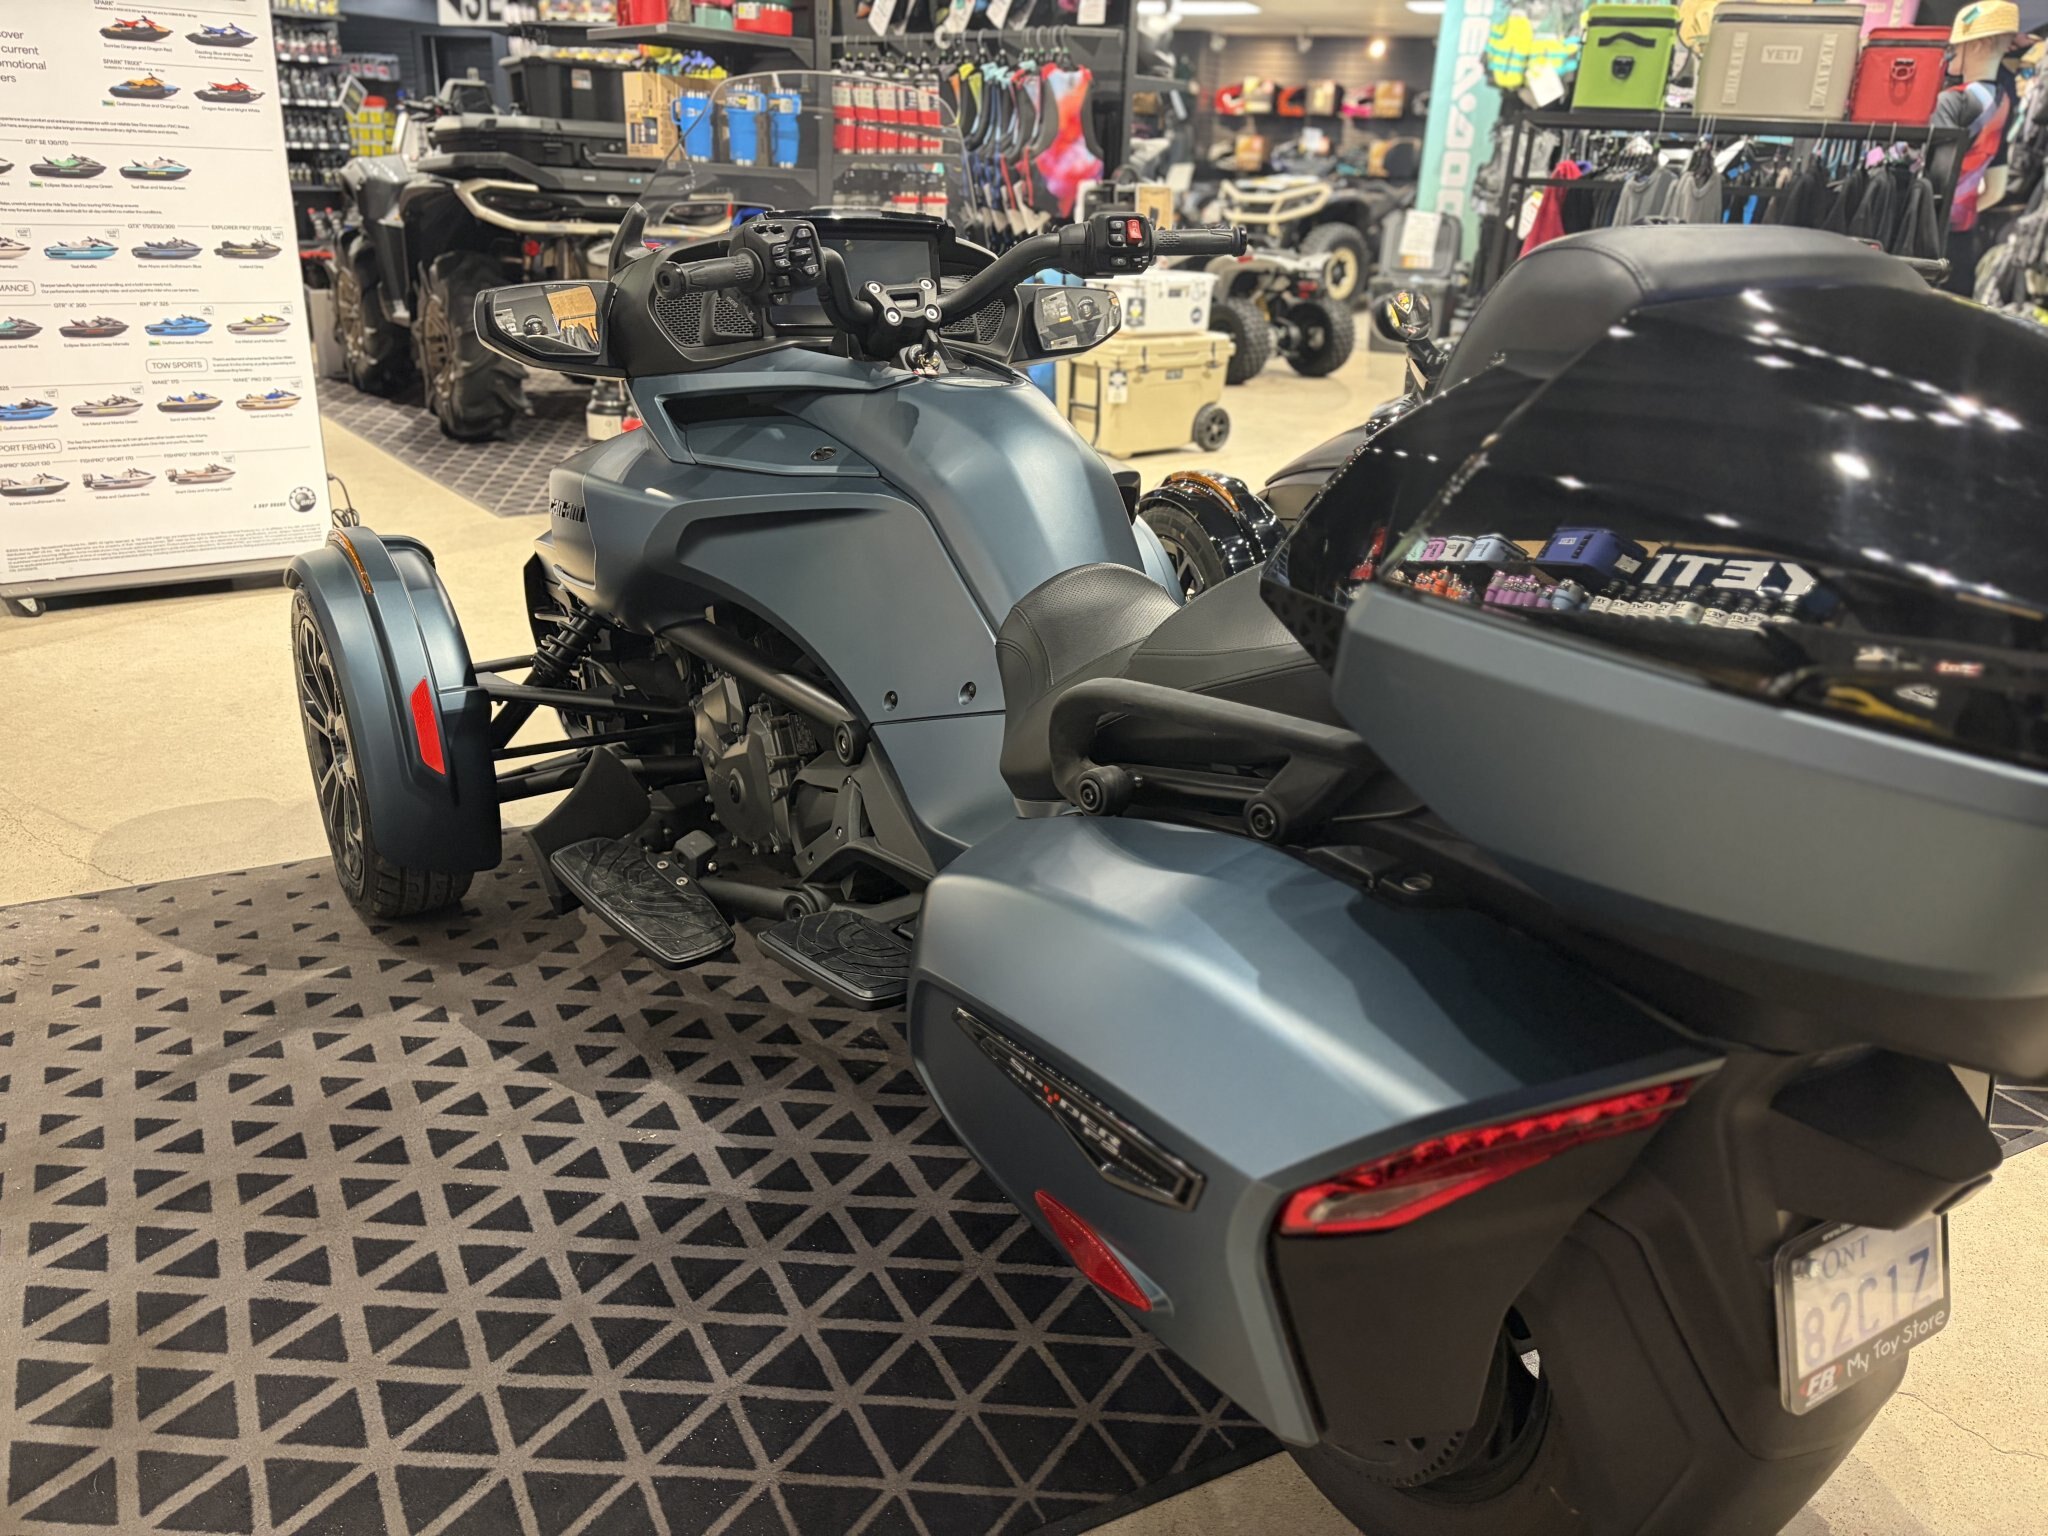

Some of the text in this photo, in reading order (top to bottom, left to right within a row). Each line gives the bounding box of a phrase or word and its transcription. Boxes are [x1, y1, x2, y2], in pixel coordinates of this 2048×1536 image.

[1, 45, 39, 56] current
[1766, 49, 1800, 61] YETI
[1010, 1056, 1121, 1146] SPYDER
[1084, 1127, 1120, 1156] F3
[1822, 1234, 1869, 1279] ONT
[1846, 1310, 1945, 1377] My Toy Store
